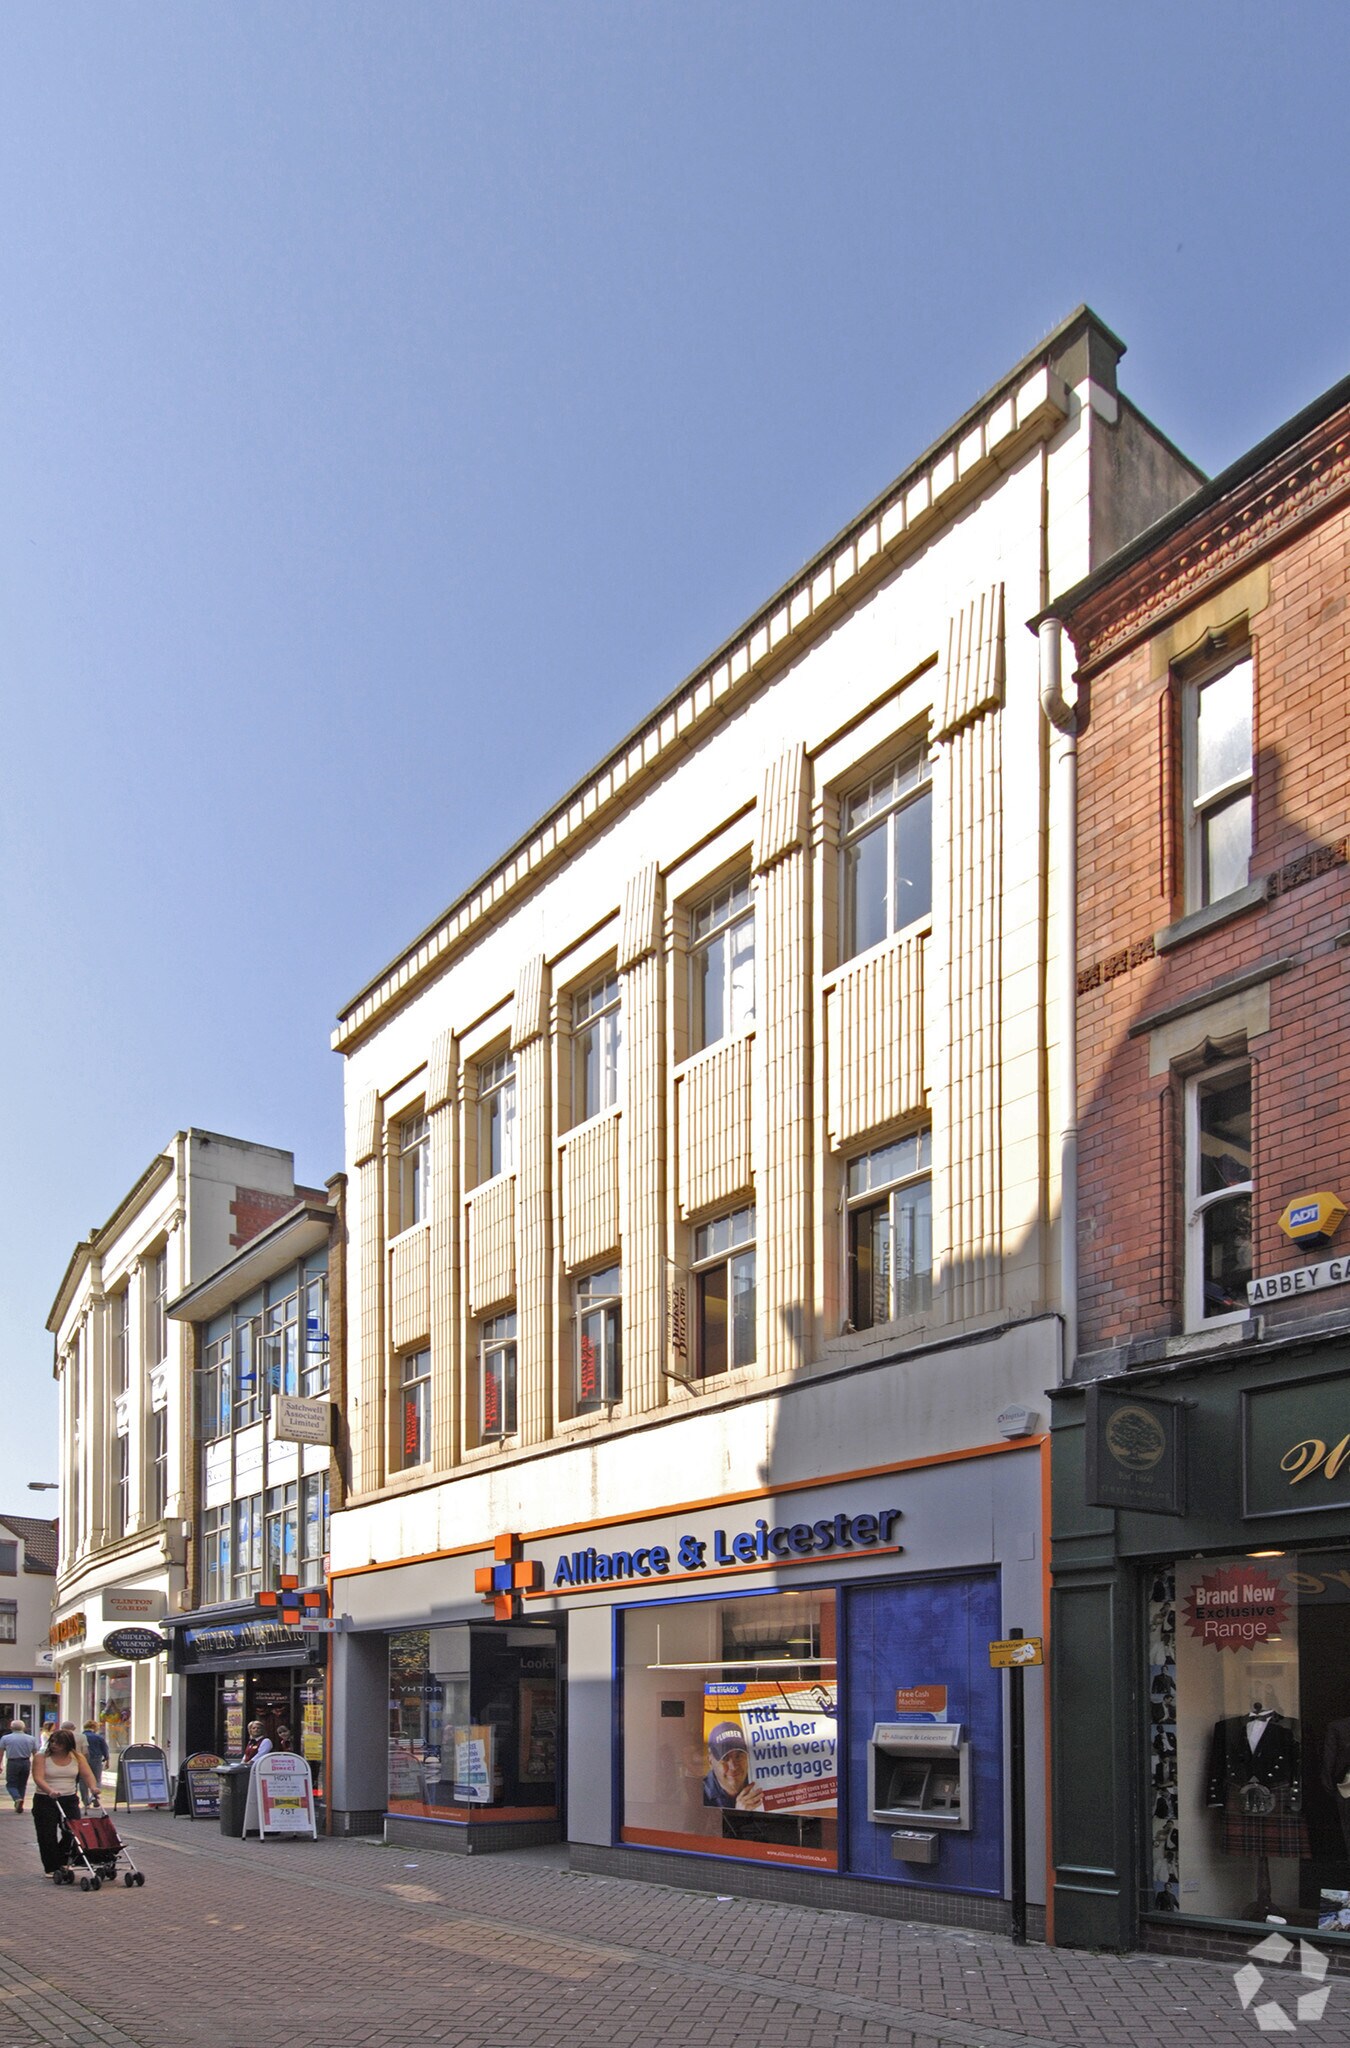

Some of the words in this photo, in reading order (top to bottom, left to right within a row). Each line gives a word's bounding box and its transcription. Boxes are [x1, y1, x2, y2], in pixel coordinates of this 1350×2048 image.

[1290, 1207, 1318, 1225] ADT
[1253, 1267, 1319, 1301] ABBEY
[284, 1409, 325, 1421] Associates
[286, 1402, 323, 1414] Satchwell
[289, 1418, 320, 1428] Limited
[553, 1547, 670, 1587] Alliance
[677, 1535, 706, 1569] &
[714, 1508, 902, 1565] Leicester
[1195, 1585, 1238, 1606] Brand
[1243, 1583, 1276, 1602] New
[1195, 1604, 1276, 1620] Exclusive
[1204, 1619, 1268, 1640] Range
[709, 1686, 739, 1694] MORTGAGES
[898, 1690, 914, 1698] Free
[914, 1690, 930, 1698] Cash
[899, 1698, 926, 1706] Machine
[747, 1704, 780, 1725] FREE
[715, 1730, 743, 1744] PLUMBER
[751, 1720, 816, 1748] plumber
[753, 1742, 788, 1761] with
[792, 1738, 837, 1756] every
[755, 1758, 833, 1780] mortgage
